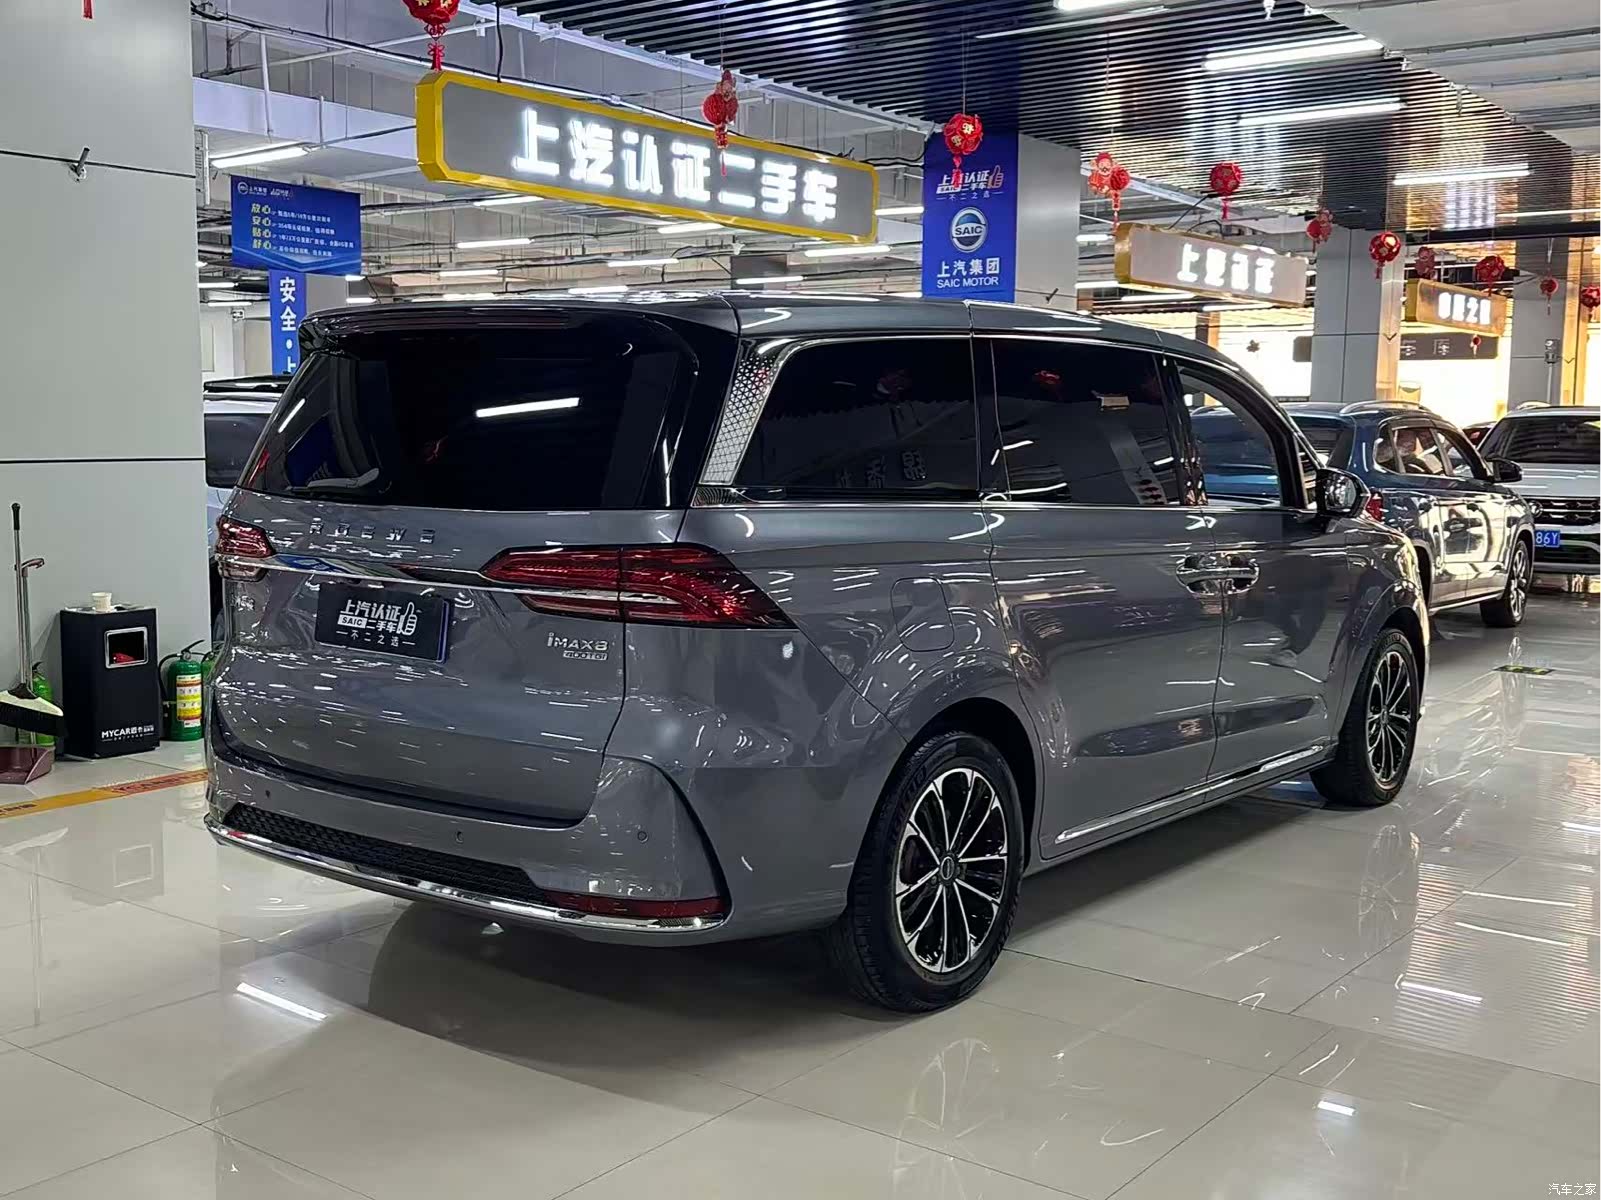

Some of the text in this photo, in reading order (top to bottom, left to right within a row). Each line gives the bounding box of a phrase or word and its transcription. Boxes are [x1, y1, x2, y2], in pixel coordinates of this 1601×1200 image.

[511, 106, 838, 223] 上汽认证二手车
[938, 170, 990, 186] 上认证
[251, 203, 271, 214] 放心
[252, 215, 272, 226] 安心
[252, 227, 272, 238] 贴心
[954, 226, 983, 236] SAIC
[936, 257, 1000, 278] 上汽集团
[936, 276, 999, 289] SAIC MOTOR
[1535, 532, 1558, 544] 86Y
[340, 599, 402, 622] 上汽认证
[341, 616, 363, 627] SAIC
[366, 619, 398, 633] 二手车
[350, 629, 399, 647] 不二之选
[101, 727, 131, 739] MYCAR
